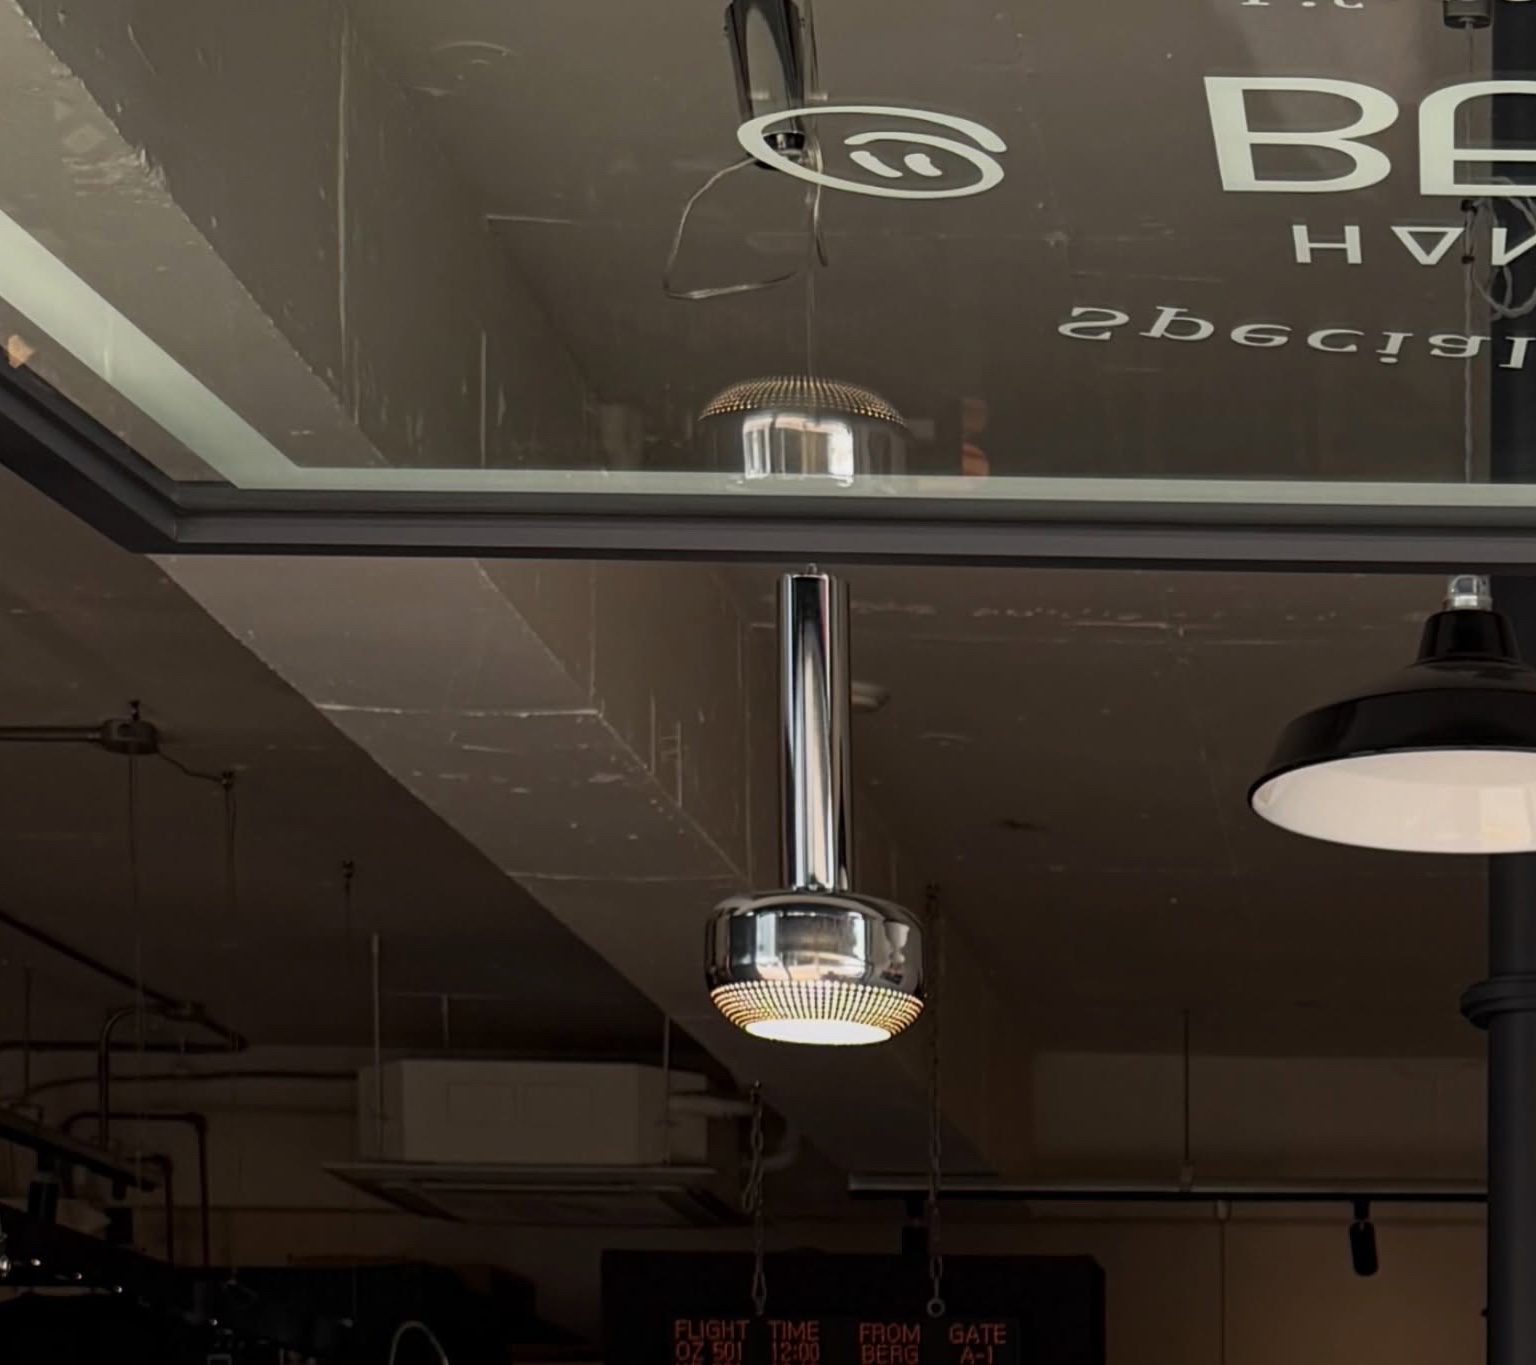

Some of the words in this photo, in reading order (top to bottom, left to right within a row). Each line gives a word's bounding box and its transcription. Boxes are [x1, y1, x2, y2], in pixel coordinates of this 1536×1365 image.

[673, 1320, 750, 1339] FLIGHT
[768, 1320, 818, 1339] TIME
[857, 1323, 921, 1342] FROM
[950, 1324, 1006, 1343] GATE
[771, 1343, 819, 1360] 12:00
[859, 1345, 918, 1362] BERG
